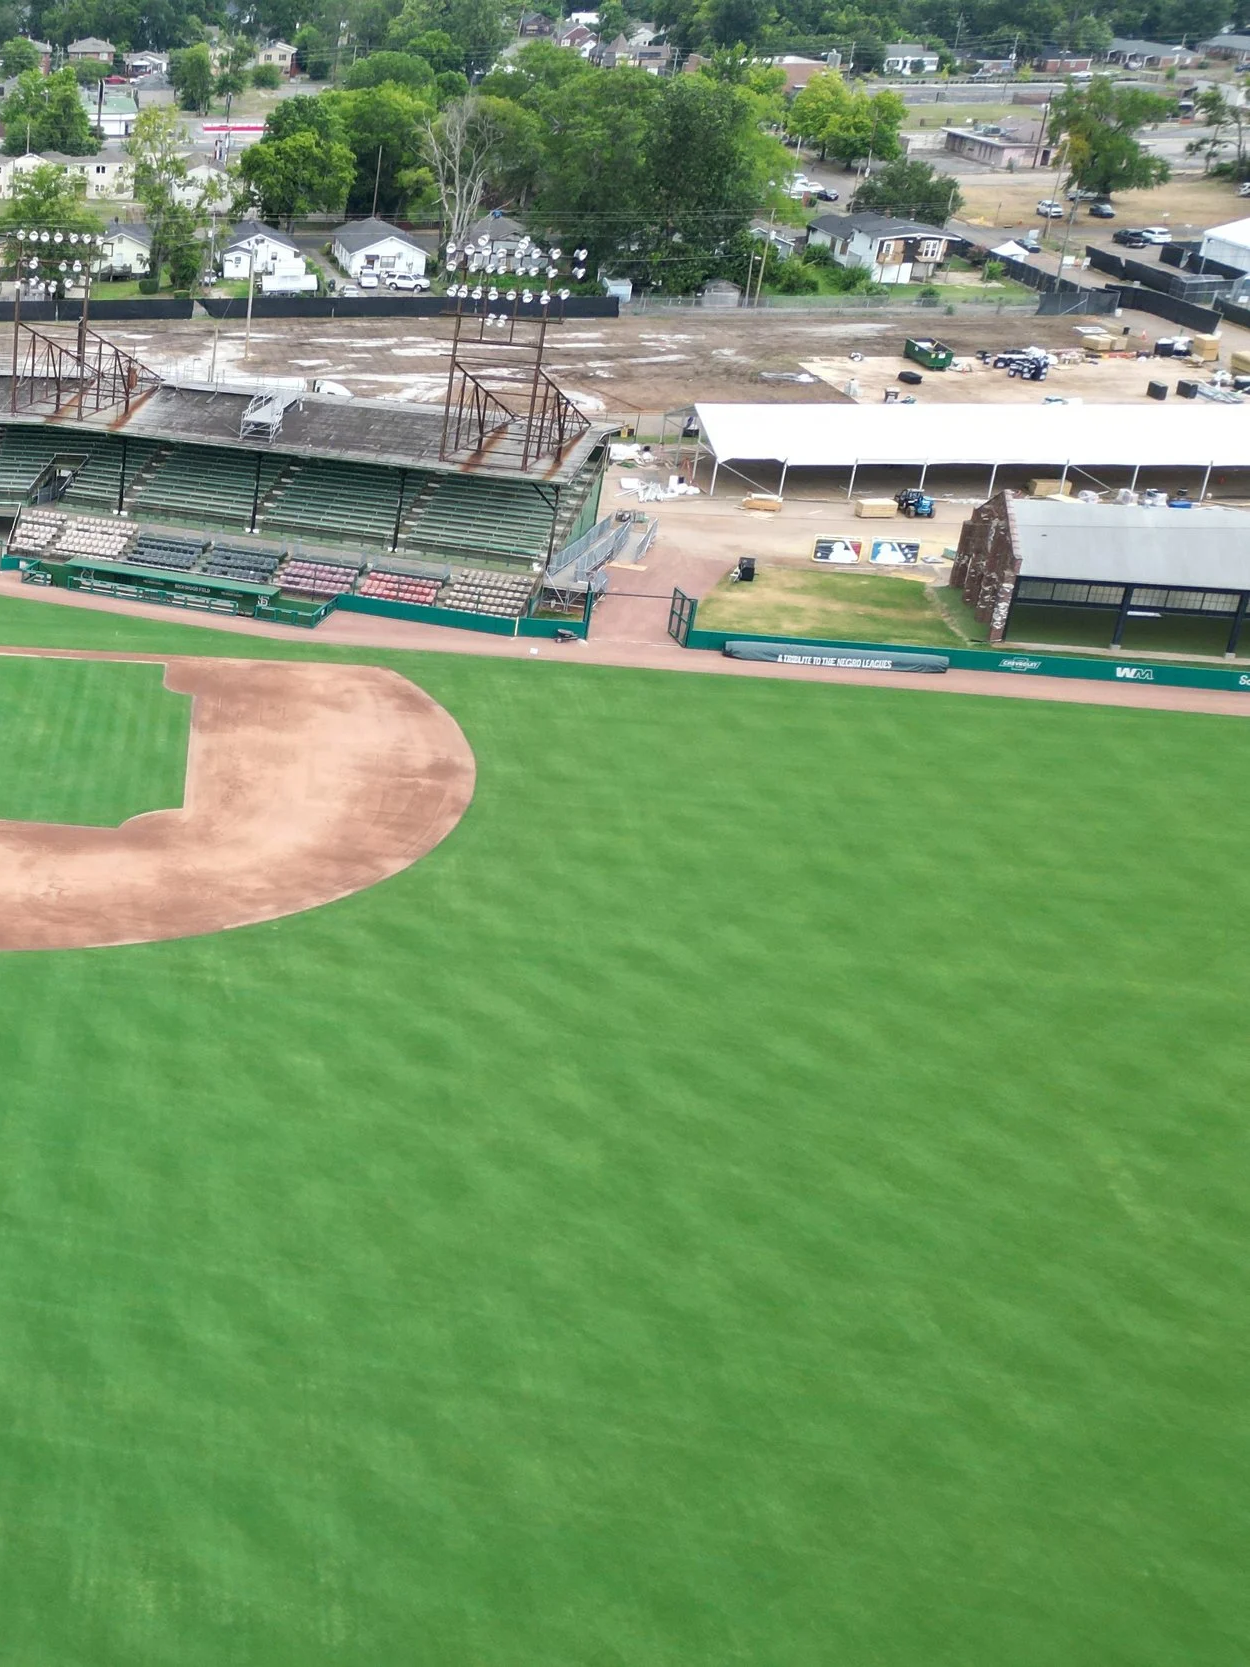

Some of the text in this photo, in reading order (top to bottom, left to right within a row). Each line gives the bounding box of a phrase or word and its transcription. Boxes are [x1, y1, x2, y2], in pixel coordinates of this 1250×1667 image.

[777, 654, 893, 669] A TRIBUTE TO THE NEGRO LEAGUES
[1115, 667, 1154, 680] WM
